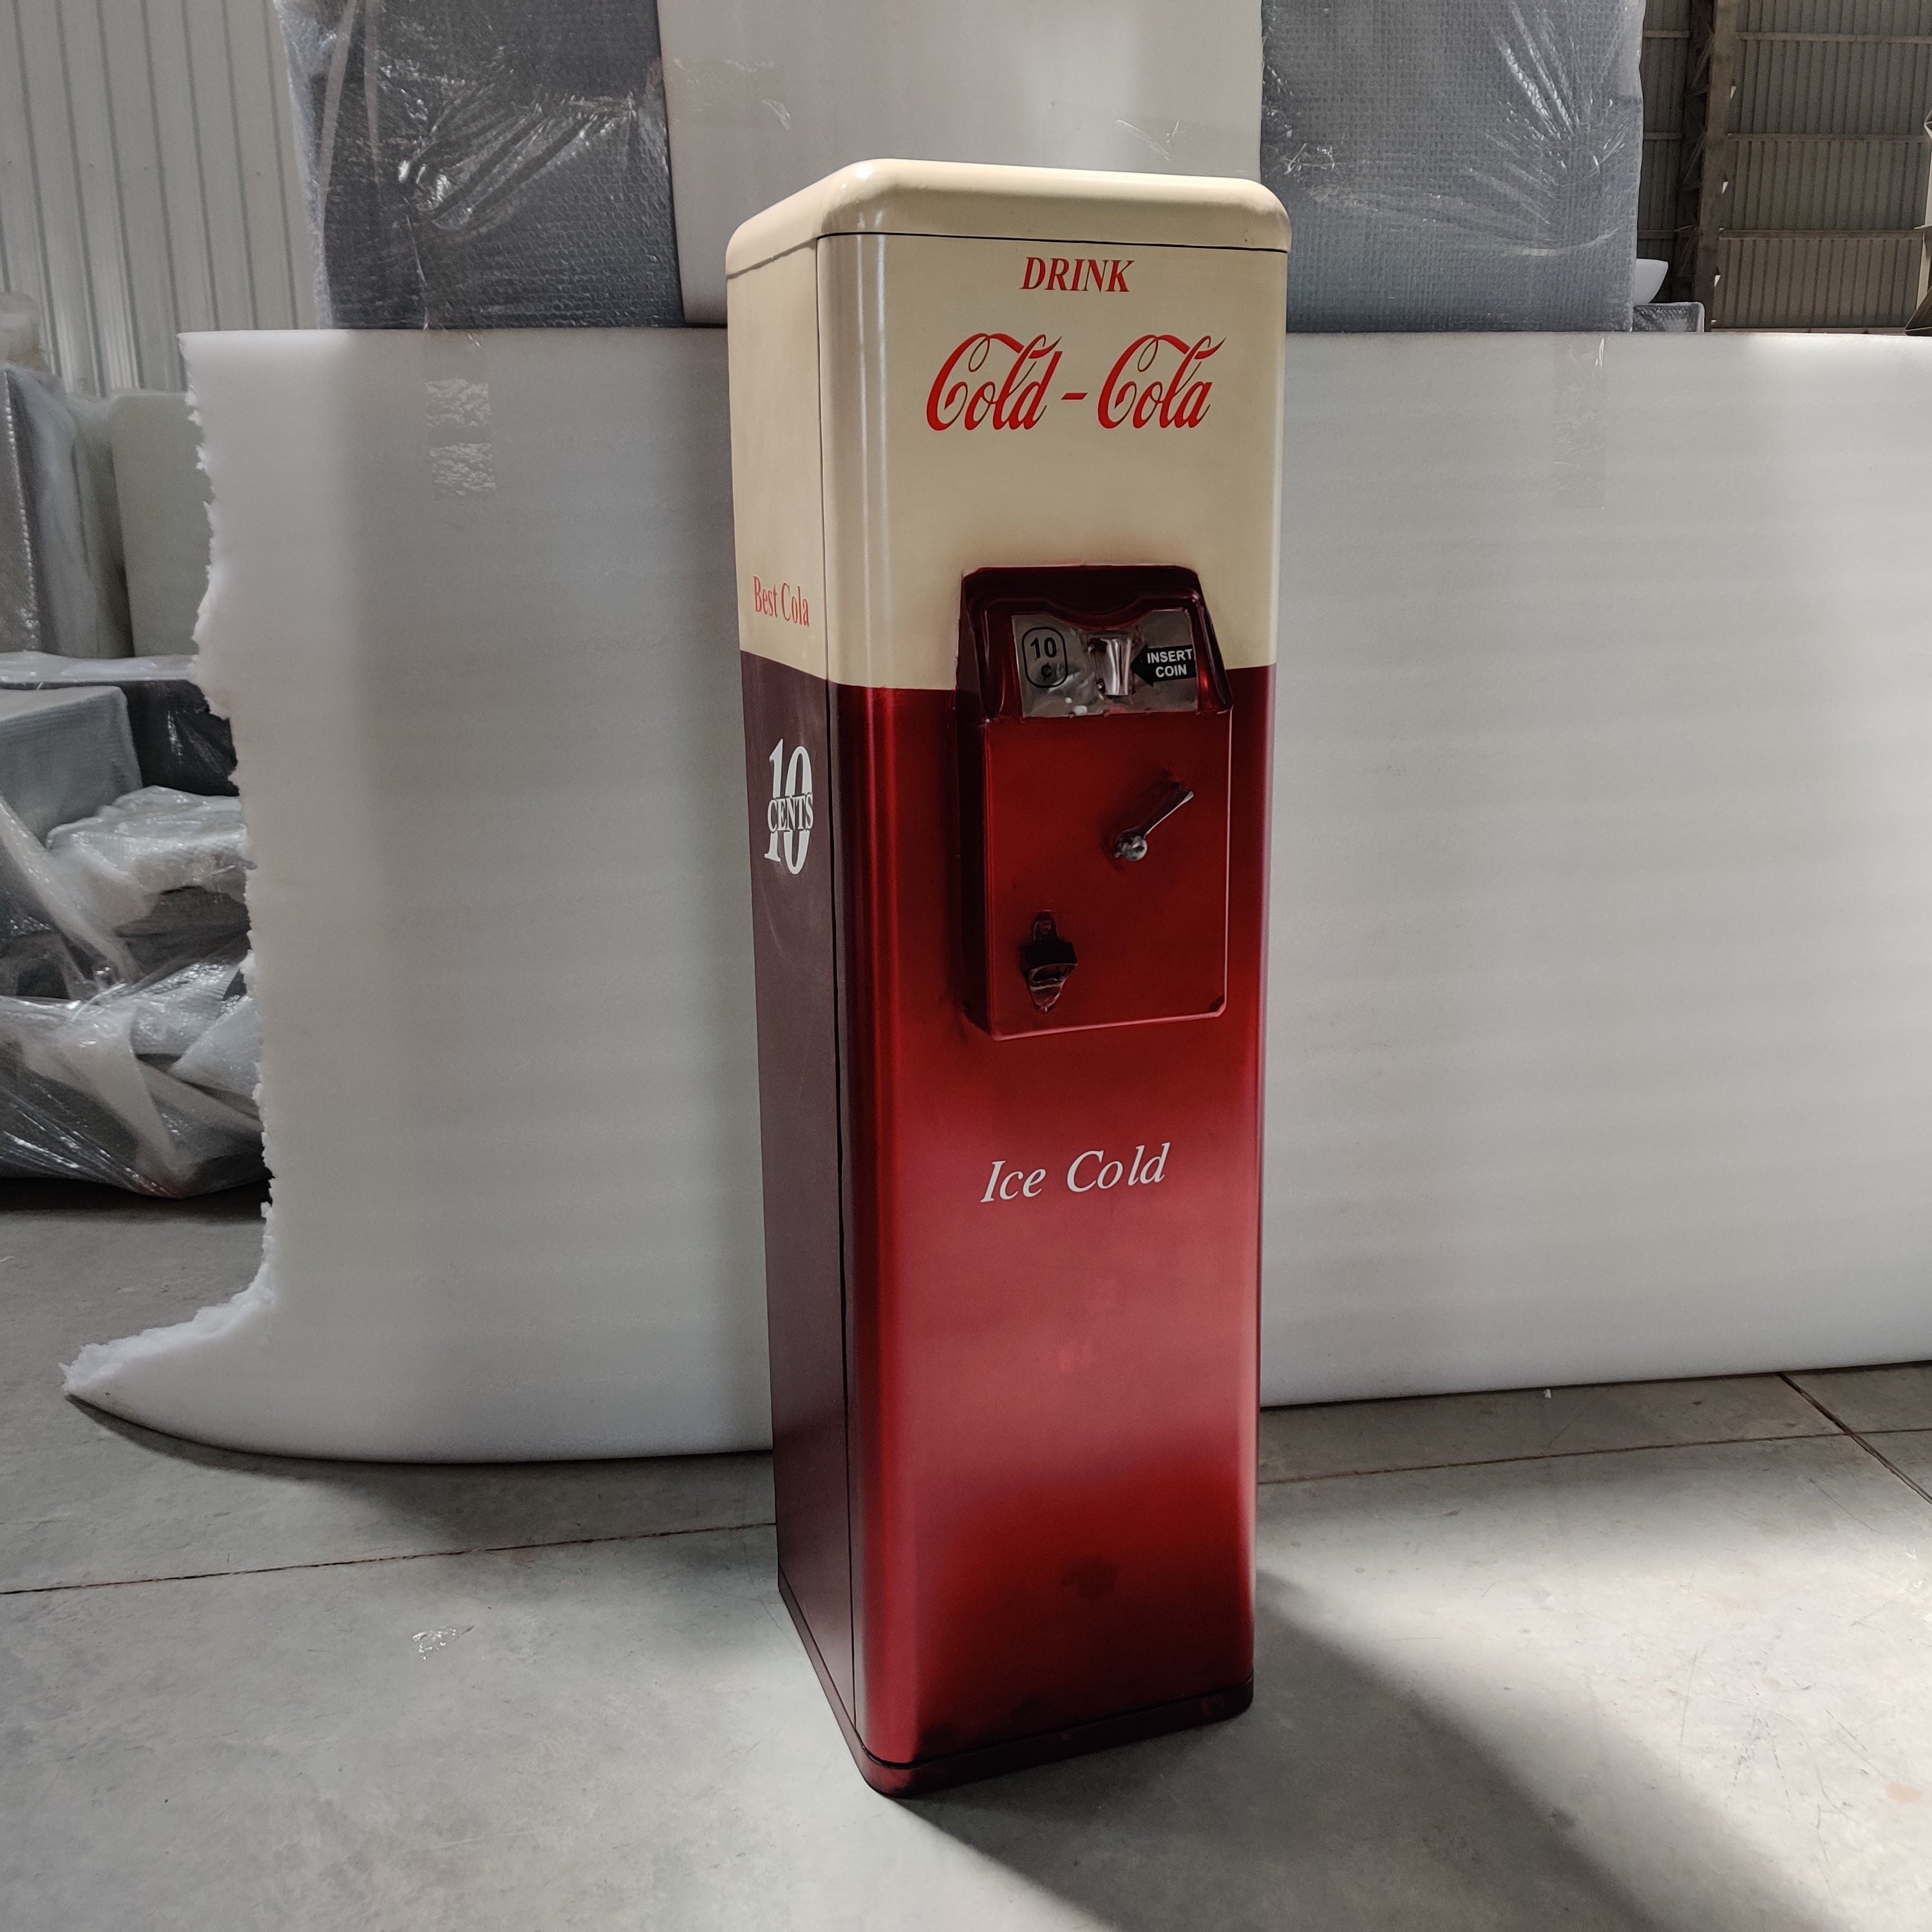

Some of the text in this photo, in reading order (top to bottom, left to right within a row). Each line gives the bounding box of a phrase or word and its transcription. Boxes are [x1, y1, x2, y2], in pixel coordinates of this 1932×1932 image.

[1019, 256, 1135, 294] DRINK
[926, 332, 1063, 431] Cold
[1097, 334, 1227, 430] Cola
[752, 574, 810, 627] Best Cola
[1030, 636, 1057, 659] 10
[1146, 648, 1193, 664] INSERT
[1155, 663, 1188, 678] COIN
[764, 737, 813, 875] 10
[767, 792, 814, 833] CENTS
[980, 1141, 1171, 1204] Ice Cold
